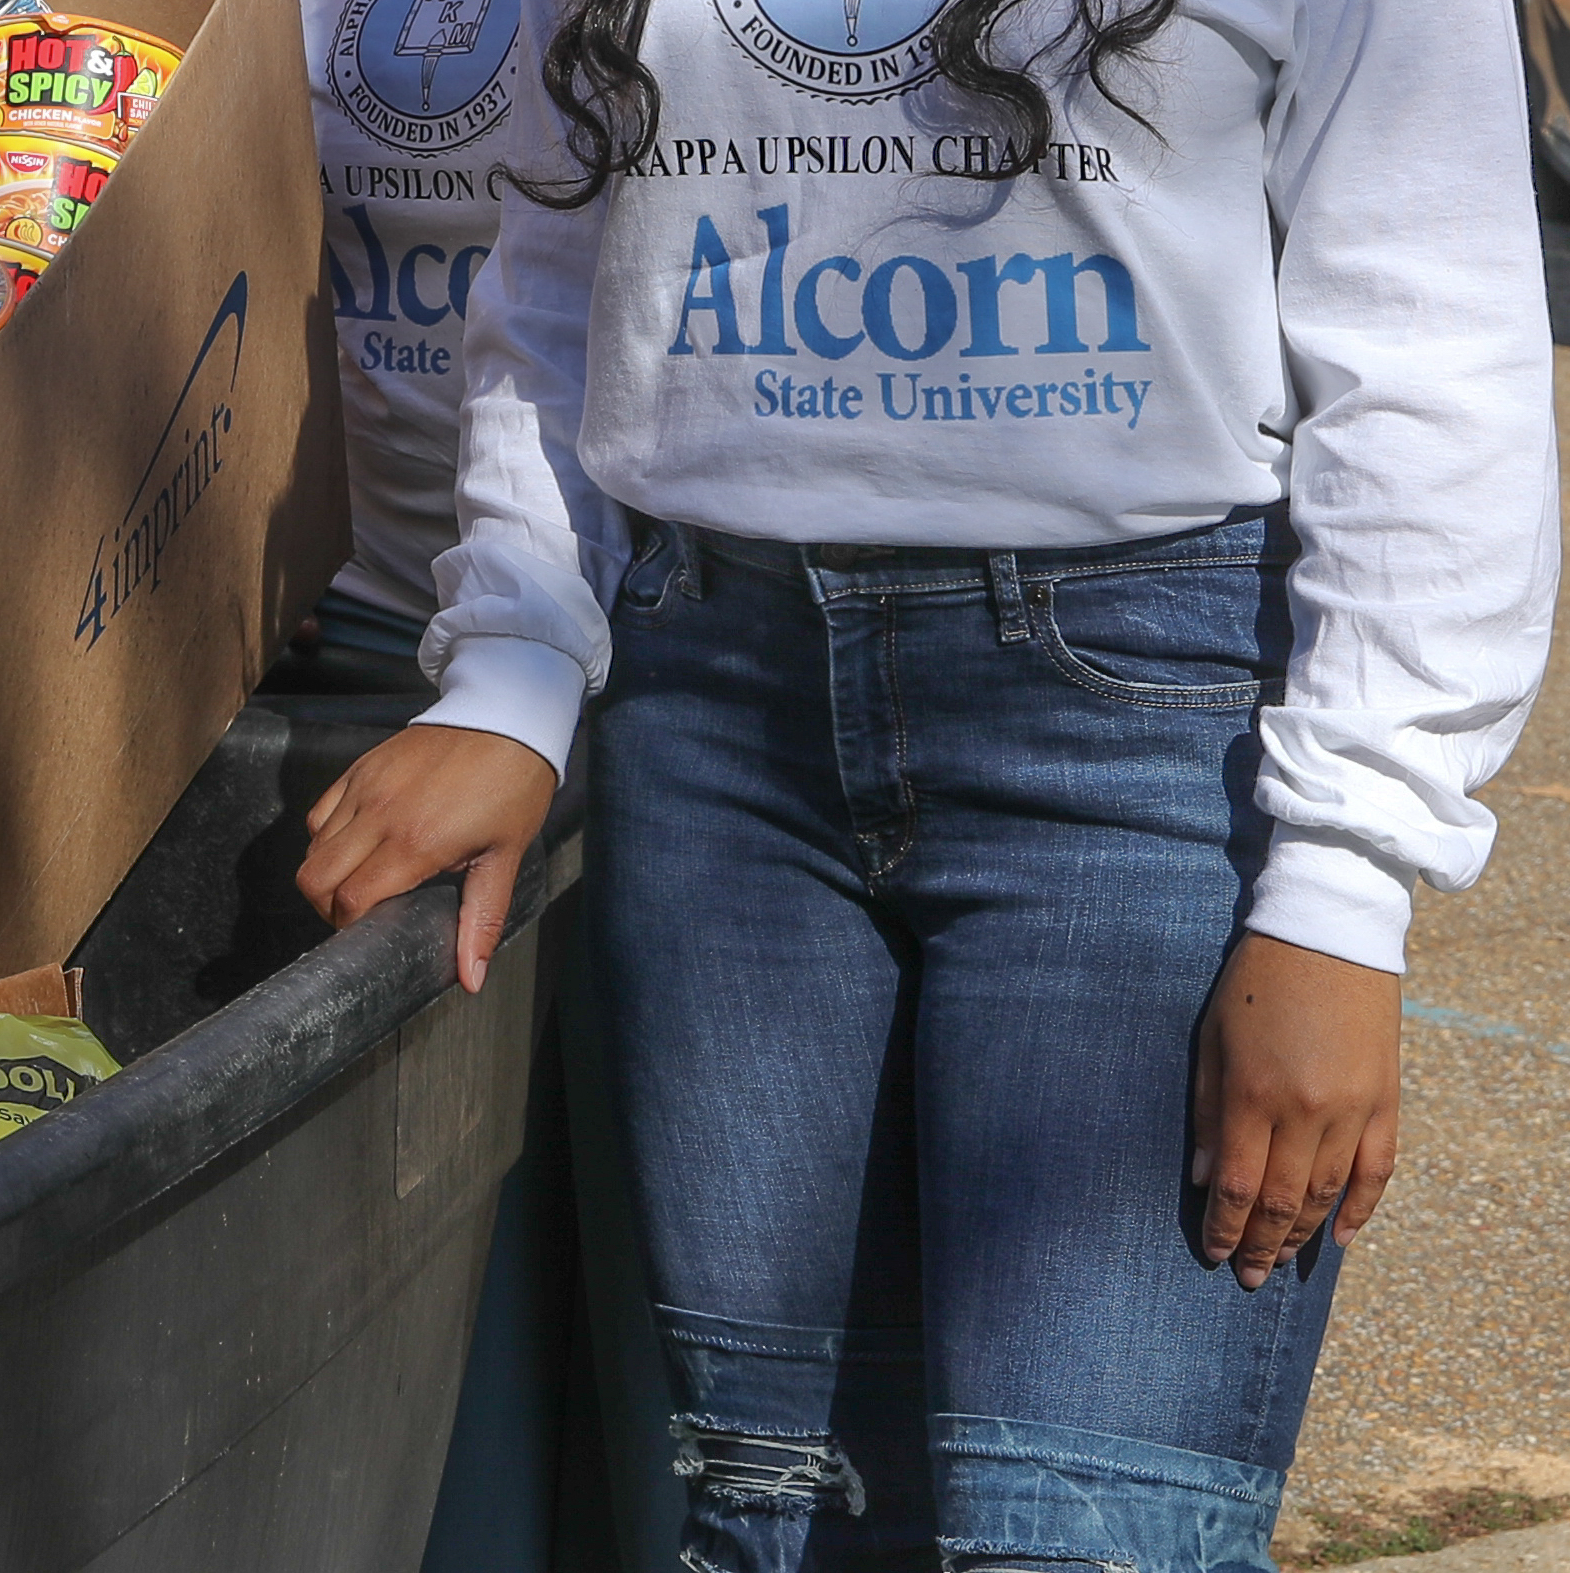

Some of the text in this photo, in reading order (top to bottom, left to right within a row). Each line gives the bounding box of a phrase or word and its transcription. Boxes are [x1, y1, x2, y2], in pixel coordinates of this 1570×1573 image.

[438, 0, 464, 24] K
[447, 22, 474, 46] M
[740, 15, 901, 87] FOUNDED IN
[10, 35, 114, 77] HOT &
[8, 72, 114, 109] SPICY
[8, 108, 103, 128] CHICKEN FLAVOR
[347, 79, 508, 144] FOUNDED IN 1937
[9, 154, 45, 168] NISSIN
[621, 134, 1121, 184] KAPPA UPSILON CHATER
[58, 162, 109, 203] HO
[343, 164, 477, 202] UPSILON
[666, 201, 1152, 362] Alcorn
[359, 331, 452, 376] State
[752, 367, 1153, 430] State University
